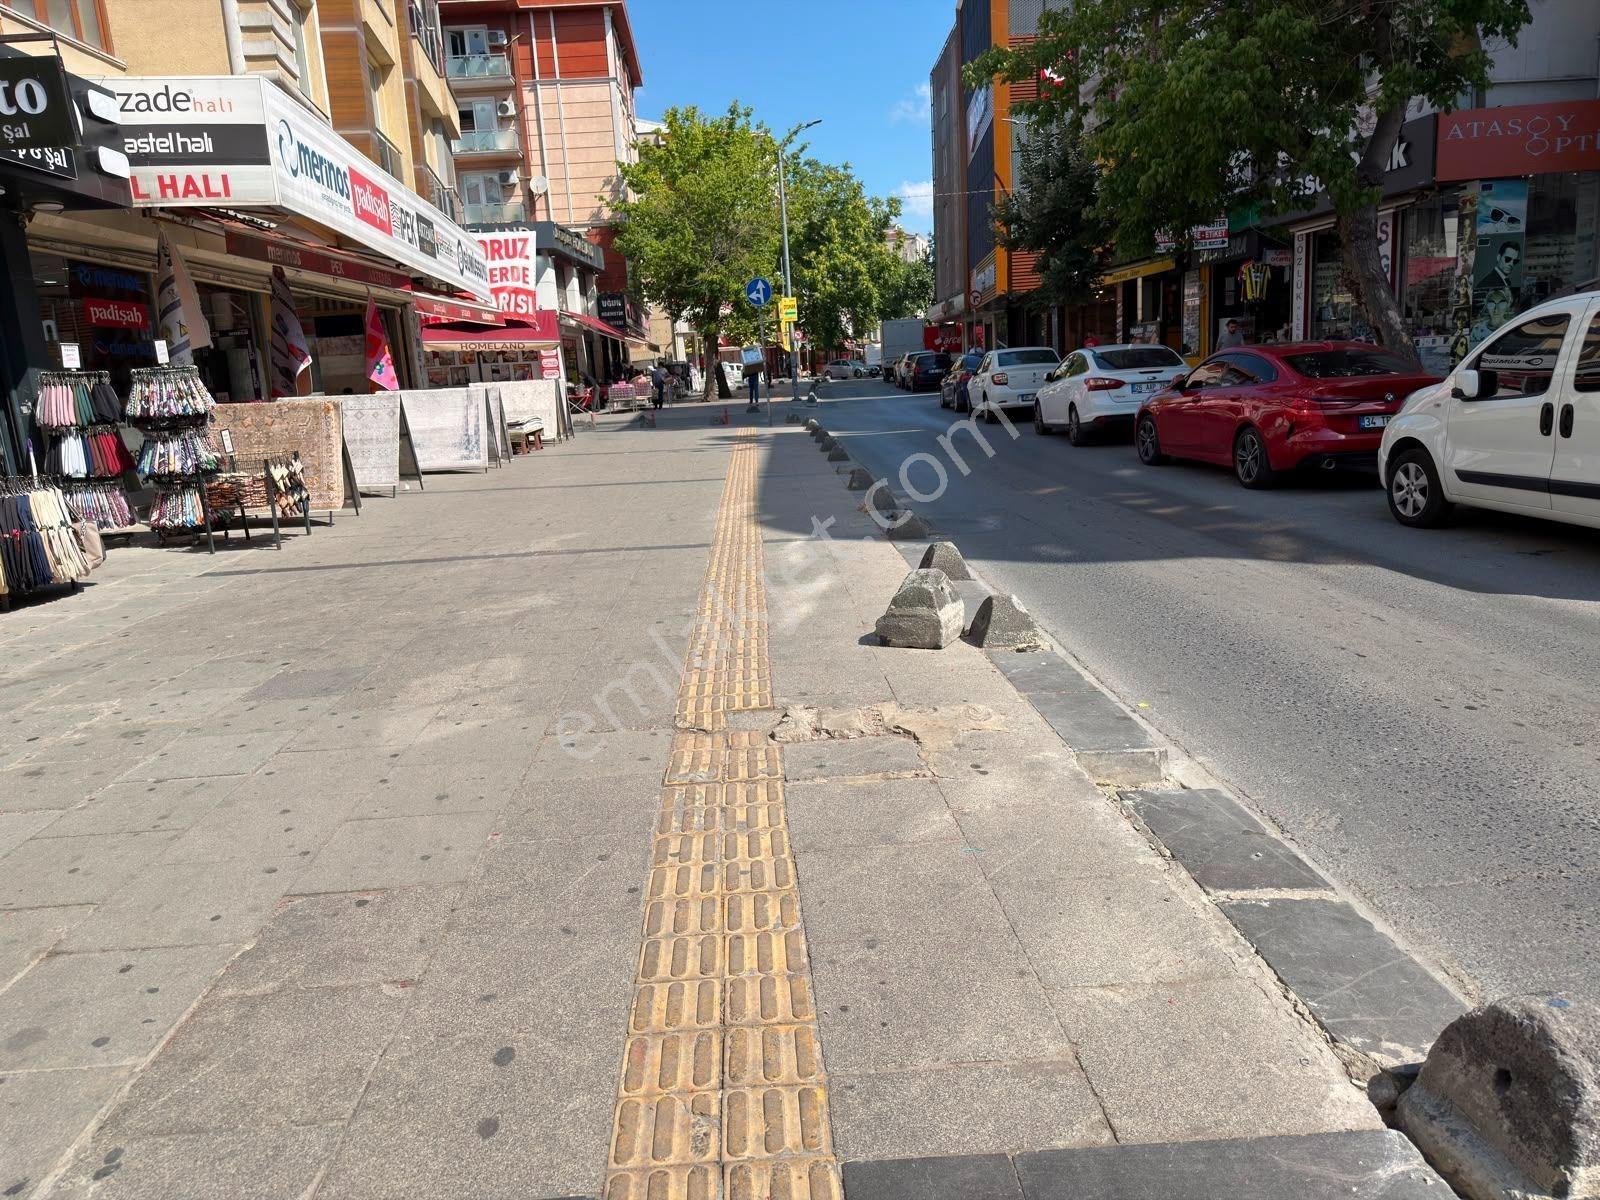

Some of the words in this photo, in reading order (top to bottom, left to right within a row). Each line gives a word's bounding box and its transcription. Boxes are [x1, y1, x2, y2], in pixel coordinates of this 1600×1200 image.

[3, 121, 31, 144] Şal
[1445, 113, 1576, 141] ATASOY
[158, 174, 232, 199] HALI
[296, 140, 351, 201] merinos
[353, 184, 389, 226] padişah
[90, 304, 142, 325] padişah
[1365, 417, 1376, 426] 34
